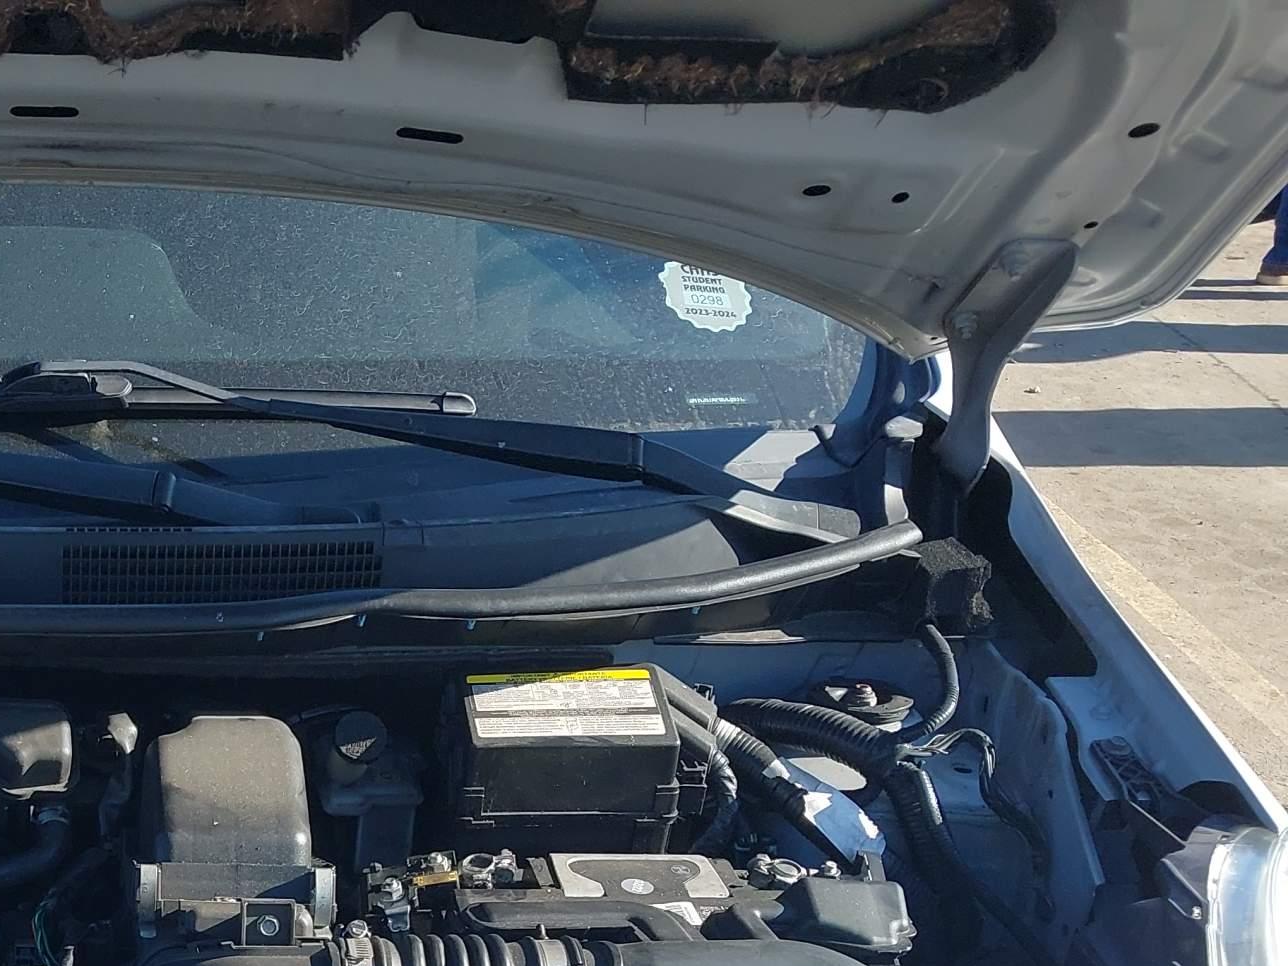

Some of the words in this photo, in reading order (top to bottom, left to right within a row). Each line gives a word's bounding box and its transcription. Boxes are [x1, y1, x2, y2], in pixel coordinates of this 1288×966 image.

[681, 275, 723, 285] STUDENT
[683, 284, 726, 294] PARKING
[690, 294, 724, 306] 0298
[684, 307, 737, 318] 2023-2024
